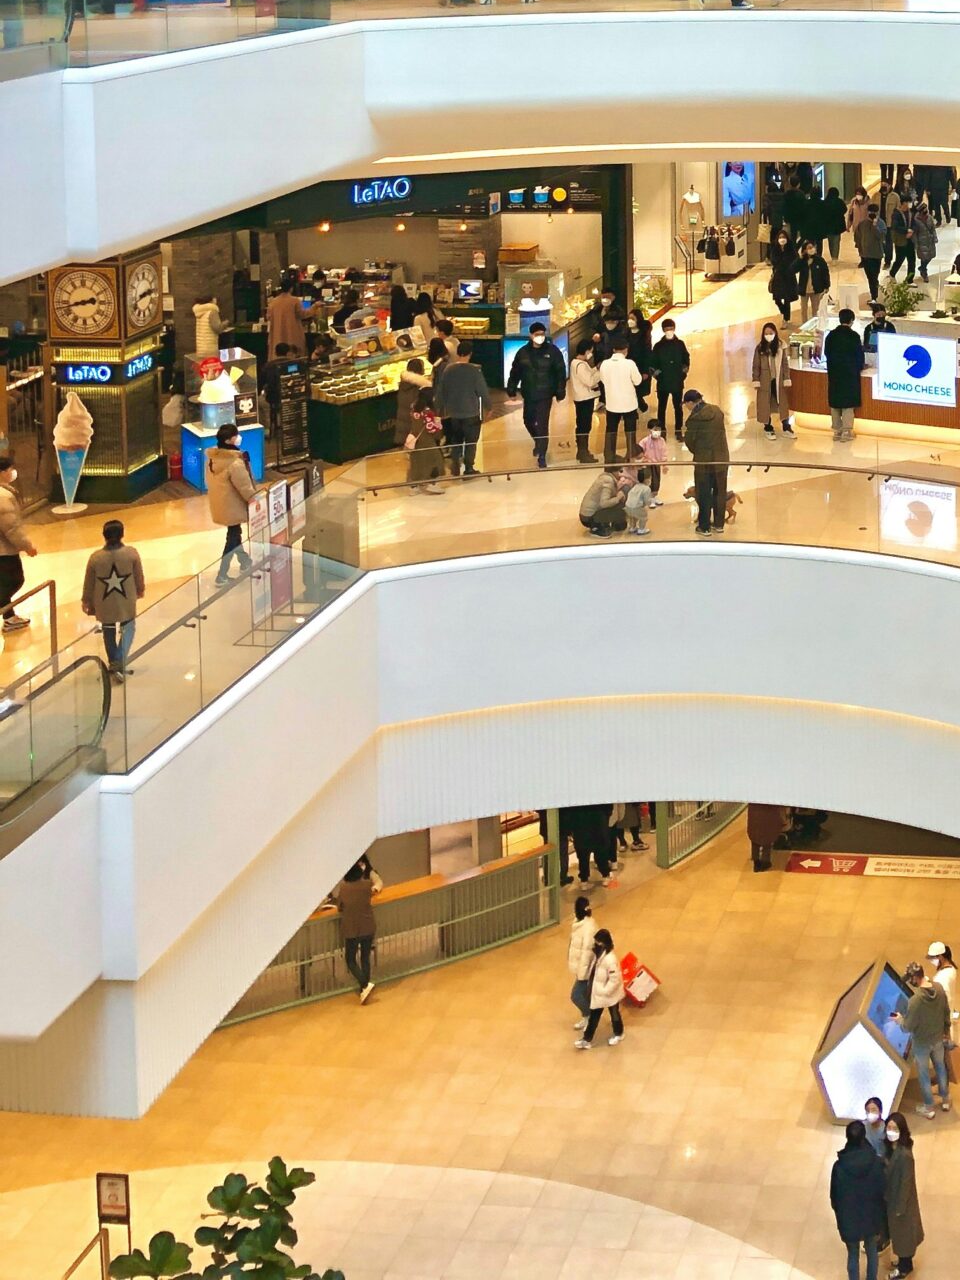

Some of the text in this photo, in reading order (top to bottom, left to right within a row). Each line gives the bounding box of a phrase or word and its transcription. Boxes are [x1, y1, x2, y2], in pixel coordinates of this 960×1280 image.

[353, 176, 411, 205] LeTAO
[68, 365, 111, 382] LeTAO
[883, 381, 952, 397] MONO CHEESE
